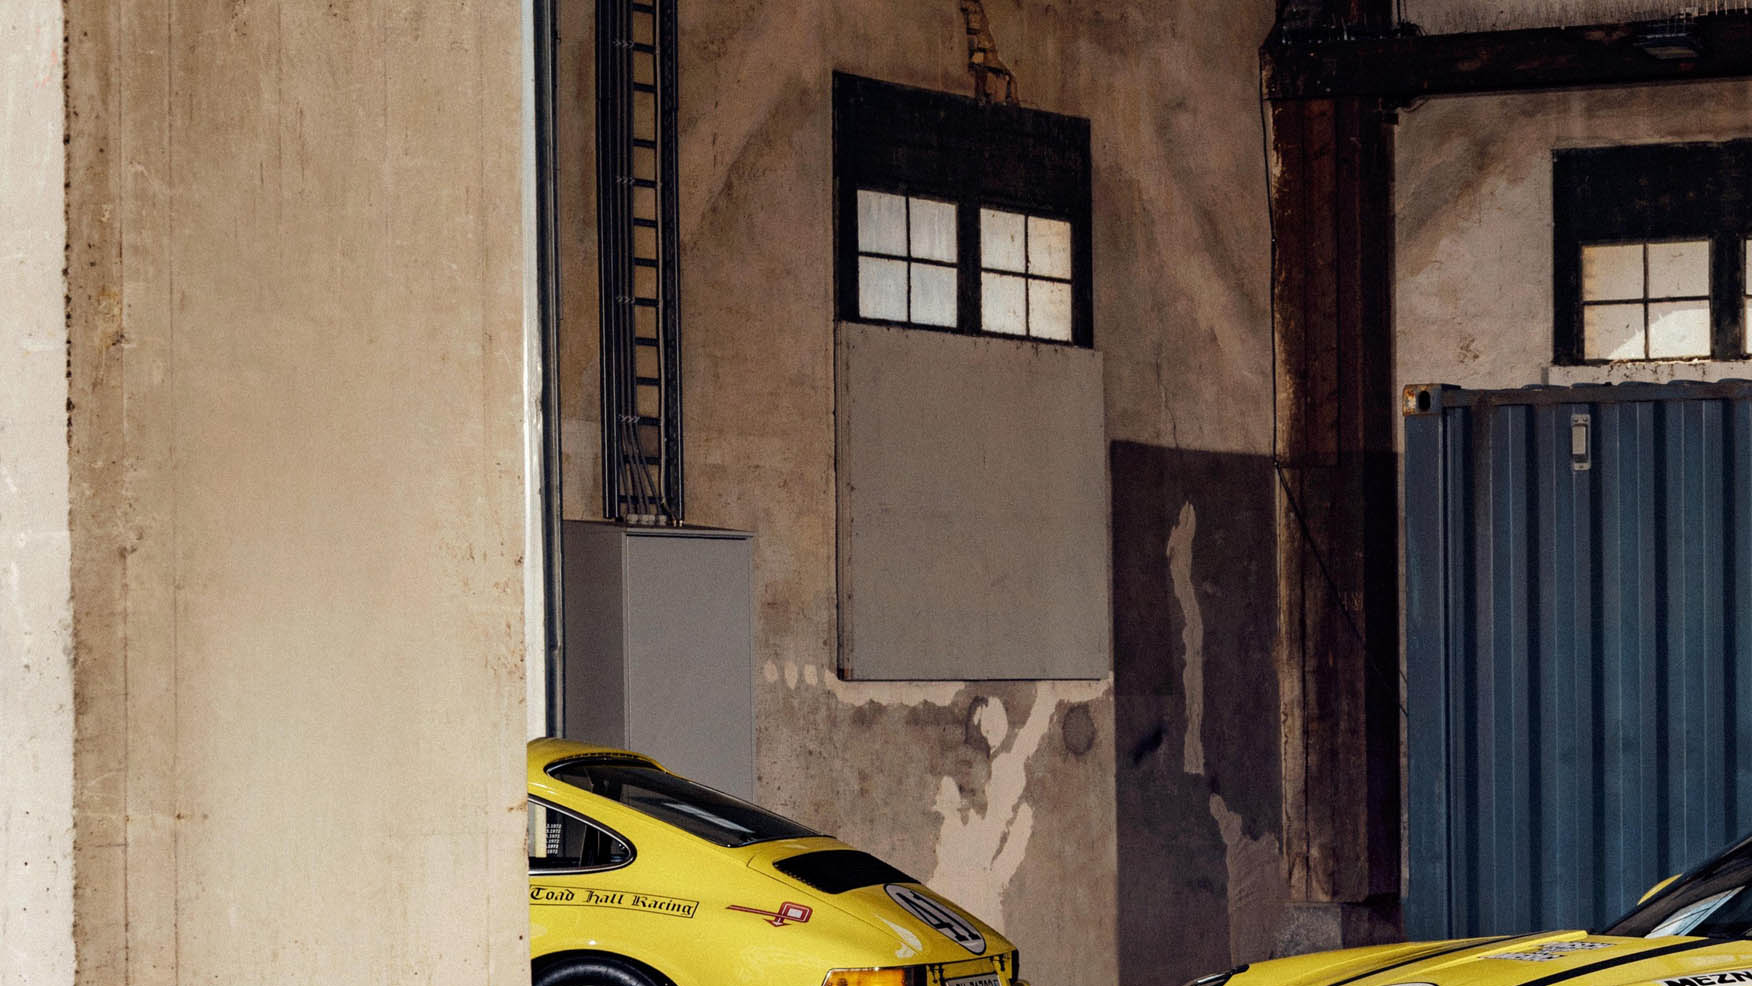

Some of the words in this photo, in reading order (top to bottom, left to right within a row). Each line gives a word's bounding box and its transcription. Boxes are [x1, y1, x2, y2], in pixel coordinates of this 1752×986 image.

[530, 887, 575, 901] Toad
[632, 895, 694, 916] Racing
[896, 890, 982, 942] 41
